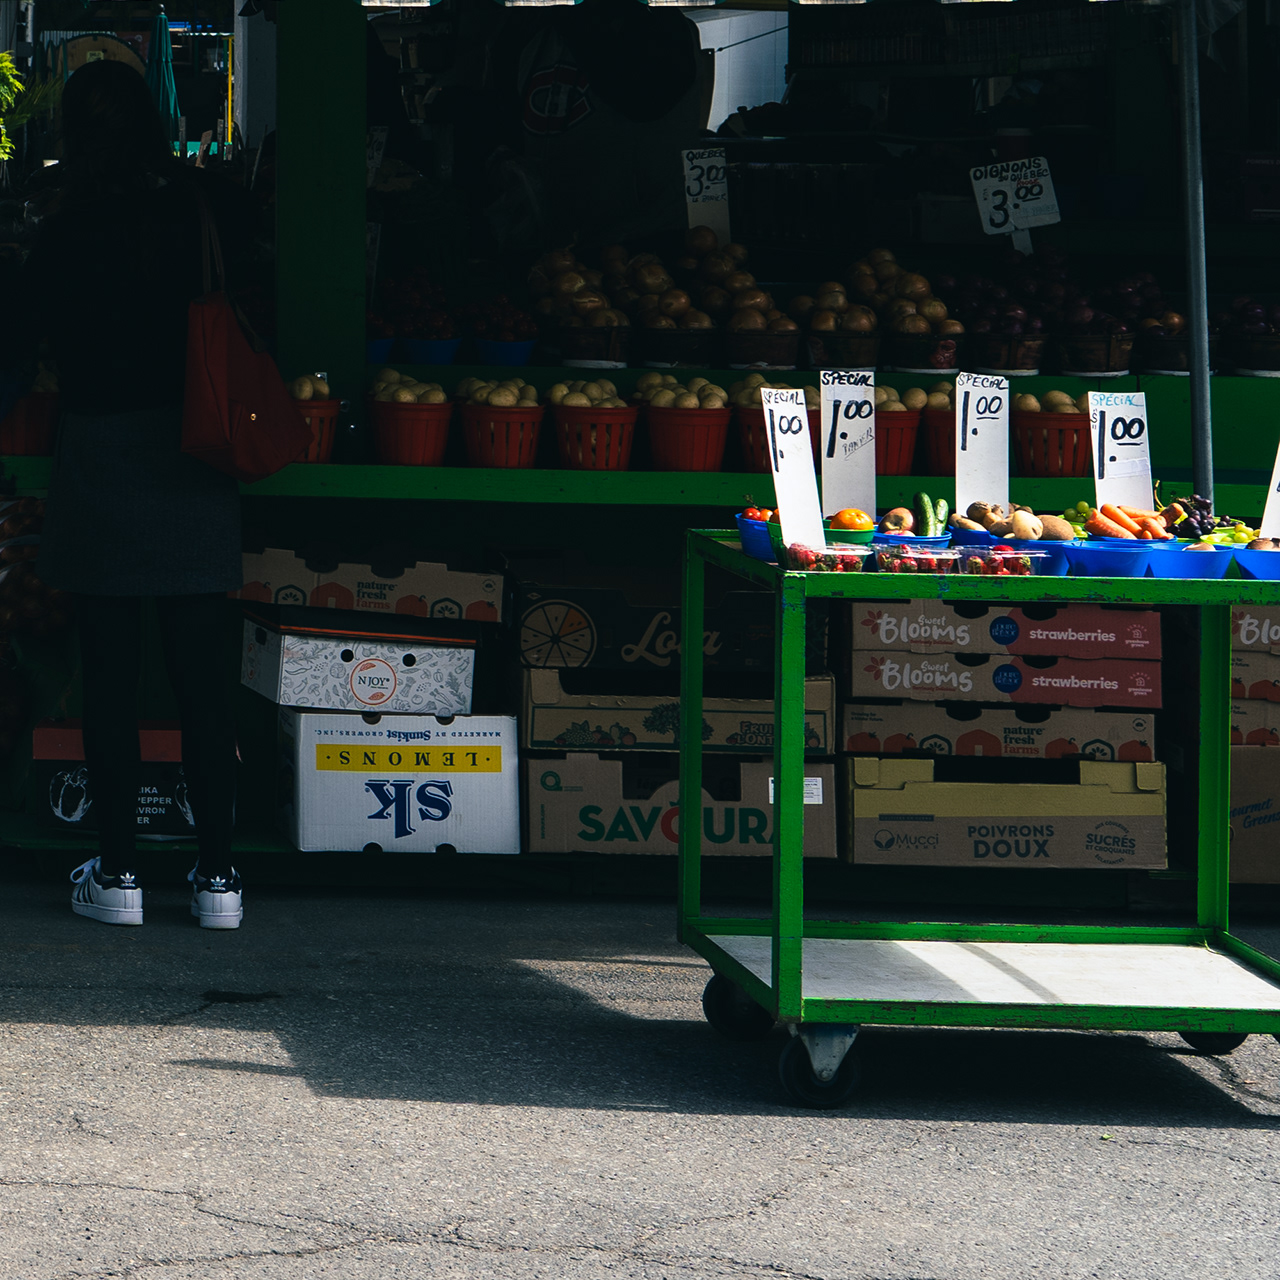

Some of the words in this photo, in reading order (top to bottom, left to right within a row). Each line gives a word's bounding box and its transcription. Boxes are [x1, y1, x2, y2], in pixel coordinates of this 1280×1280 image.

[973, 158, 1042, 181] OIGNONS
[357, 581, 395, 592] nature
[357, 589, 387, 600] fresh
[355, 598, 391, 610] farms
[918, 615, 946, 626] Sweet
[877, 613, 970, 646] Blooms
[1029, 628, 1116, 642] strawberries
[920, 660, 949, 672] Sweet
[880, 659, 973, 692] Blooms
[1032, 676, 1119, 690] strawberries
[387, 729, 431, 742] Sunkist
[1003, 725, 1043, 736] nature
[1003, 734, 1035, 745] fresh
[1002, 743, 1039, 755] farms
[339, 751, 478, 767] LEMONS
[968, 825, 1054, 838] POIVRONS
[896, 833, 939, 845] Mucci
[1086, 833, 1136, 849] SUCRÉS
[973, 839, 1050, 858] DOUX
